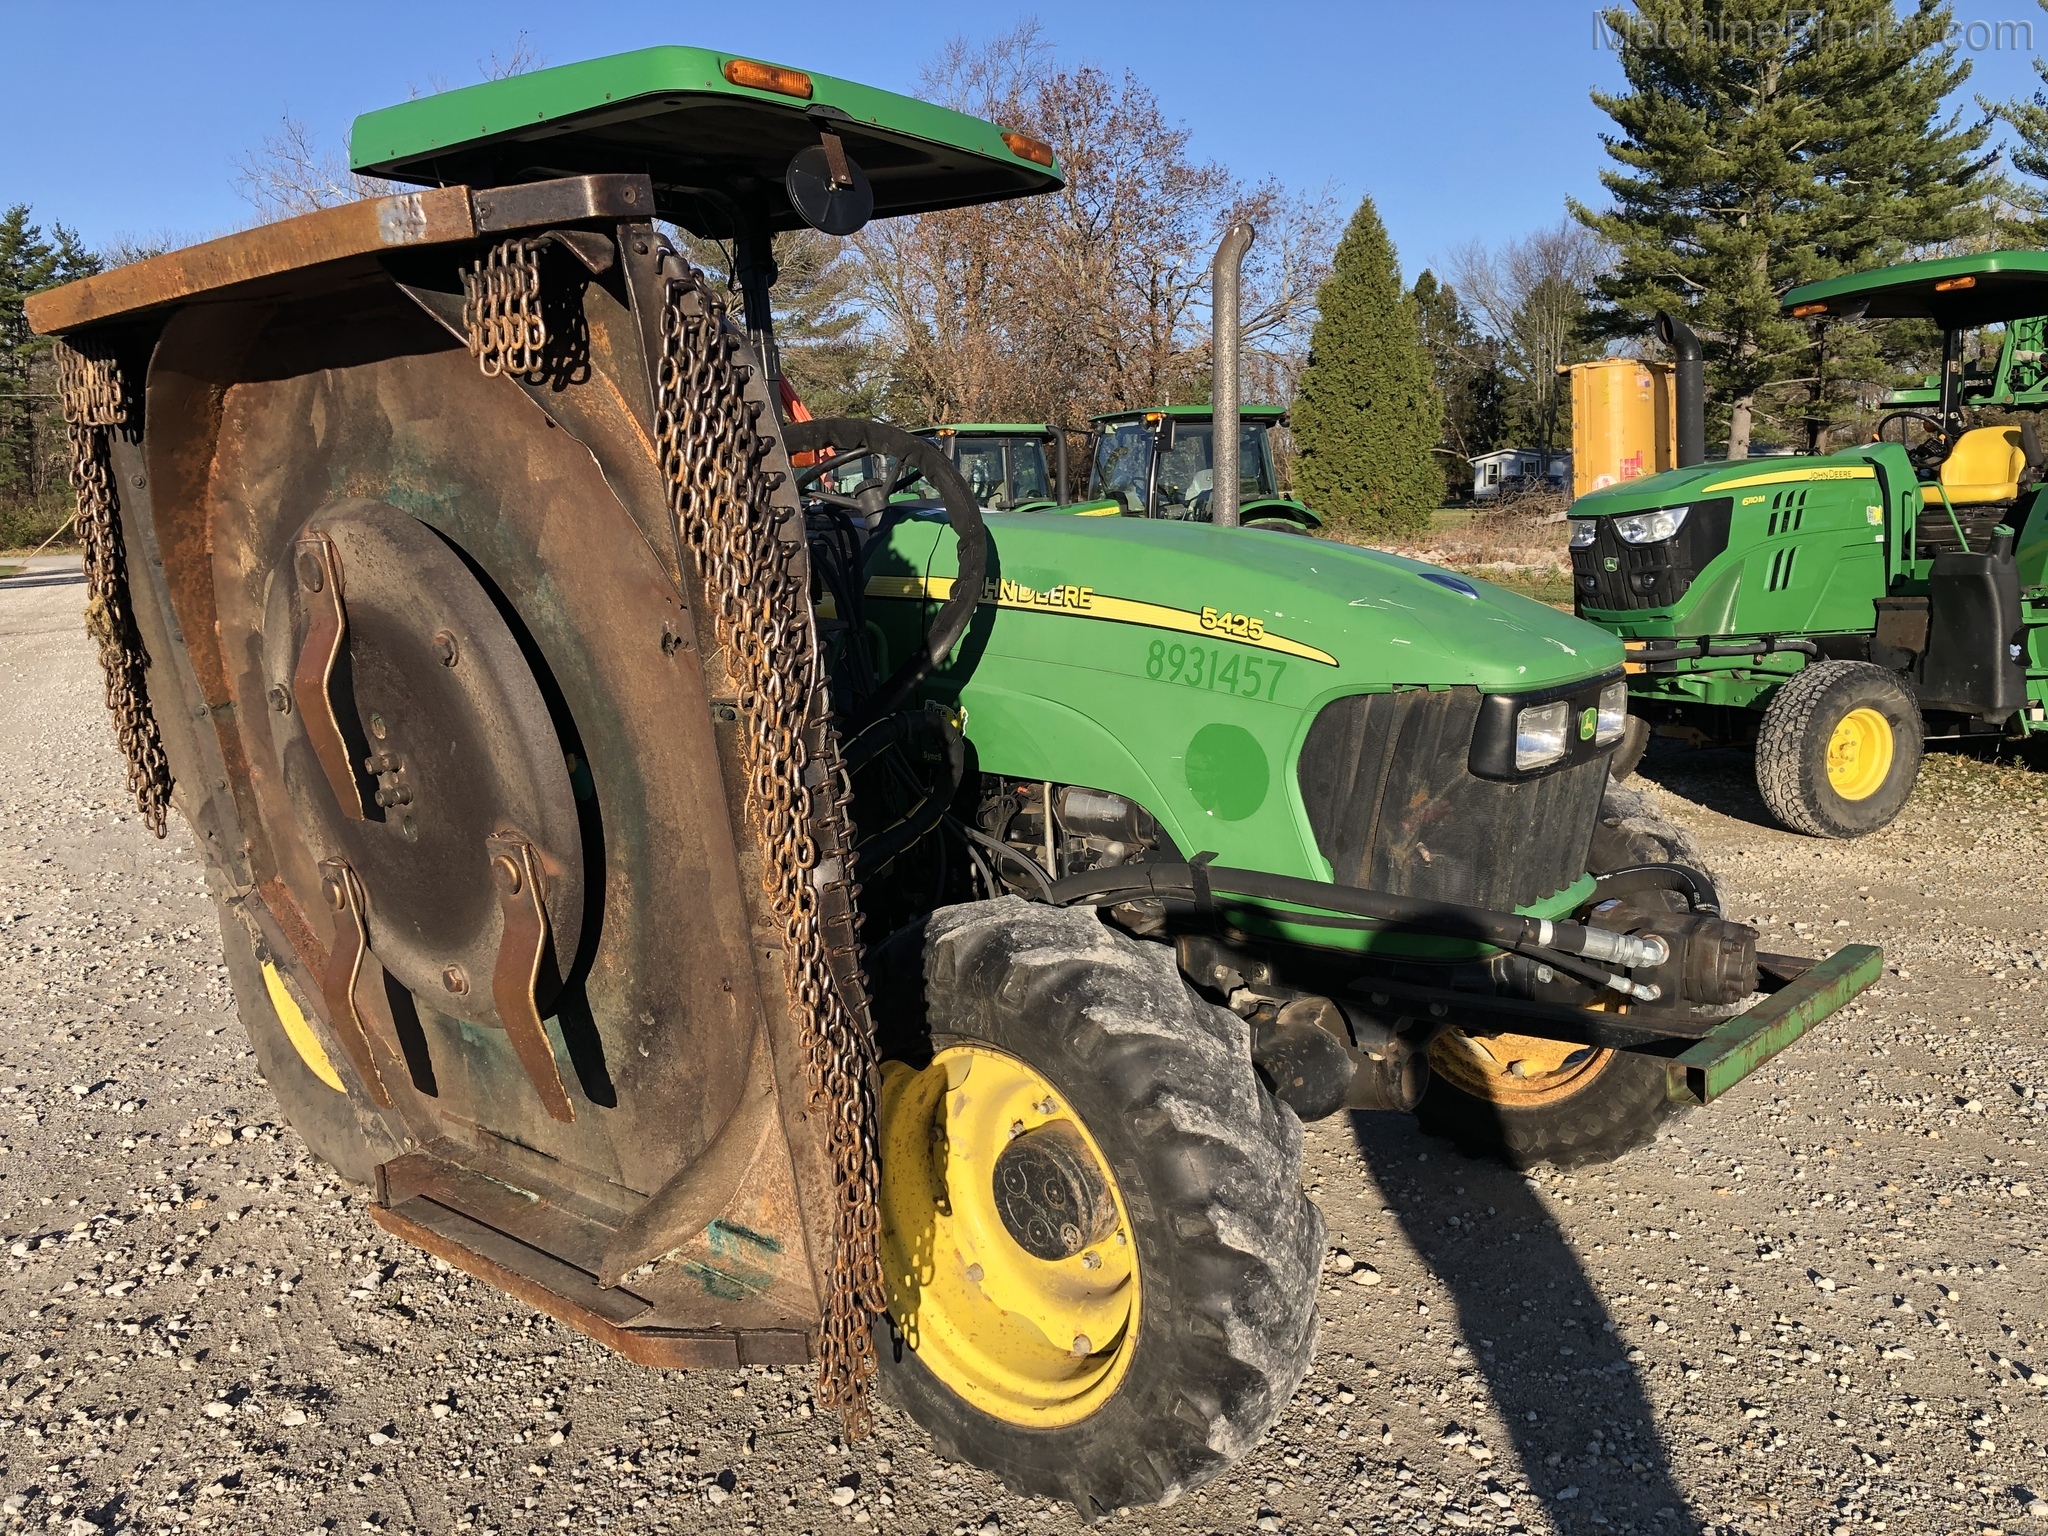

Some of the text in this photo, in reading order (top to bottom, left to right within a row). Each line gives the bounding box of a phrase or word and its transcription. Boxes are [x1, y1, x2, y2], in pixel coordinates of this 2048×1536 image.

[1809, 469, 1852, 480] JOHN DEERE
[983, 577, 1016, 602] HN
[1200, 606, 1264, 640] 5425
[1146, 639, 1287, 701] 8931457
